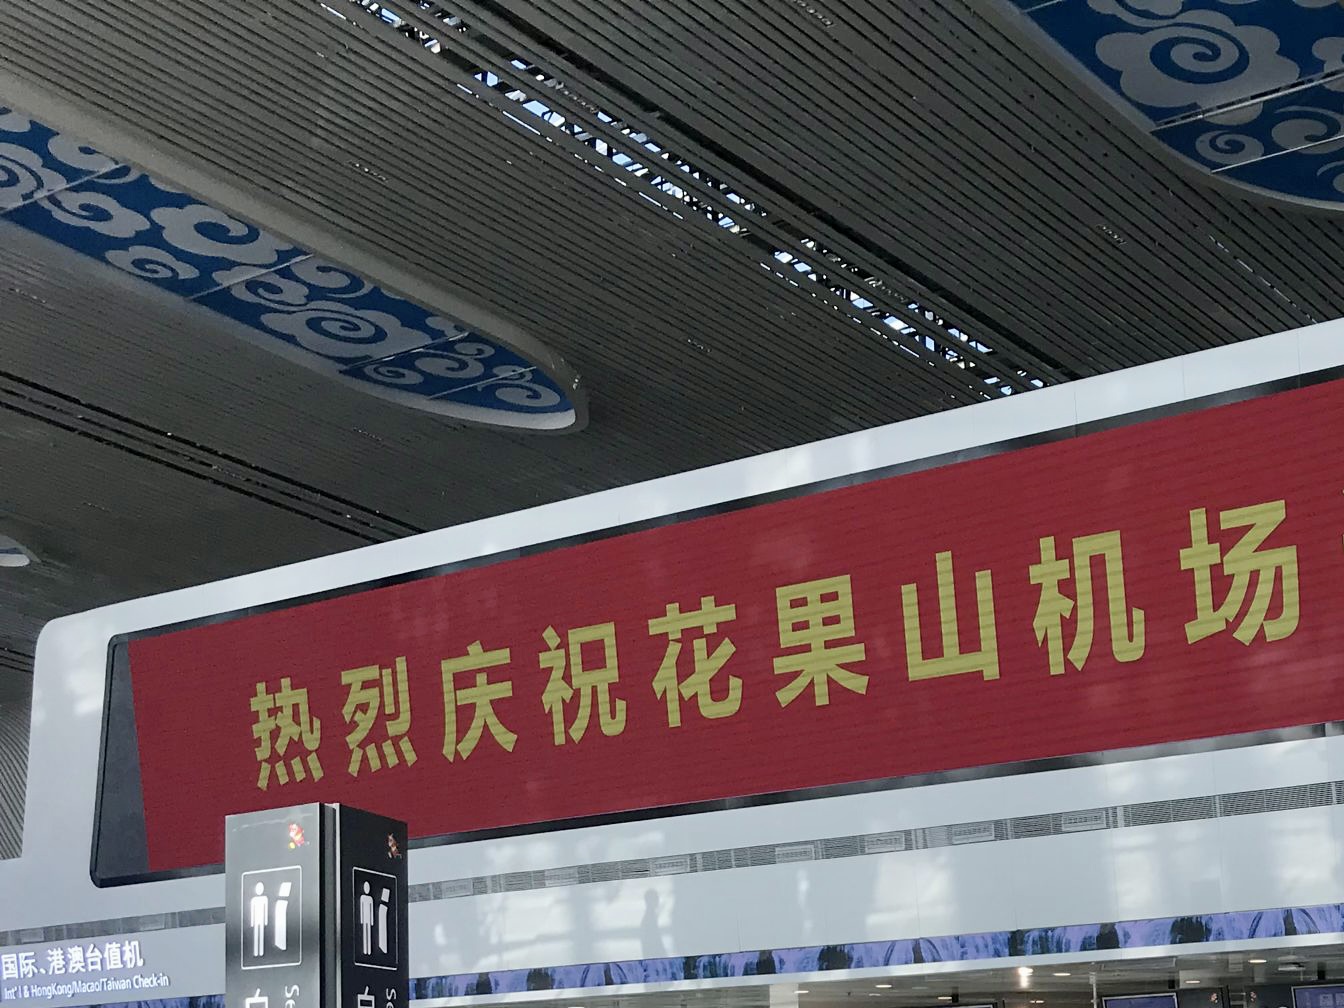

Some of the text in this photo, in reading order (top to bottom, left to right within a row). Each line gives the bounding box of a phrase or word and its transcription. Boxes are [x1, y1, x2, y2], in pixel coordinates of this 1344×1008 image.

[1, 940, 145, 980] 国际、港澳台值机
[23, 984, 30, 999] &
[31, 978, 132, 999] HongKong/Macao/Taiwan
[133, 973, 169, 989] Check-in
